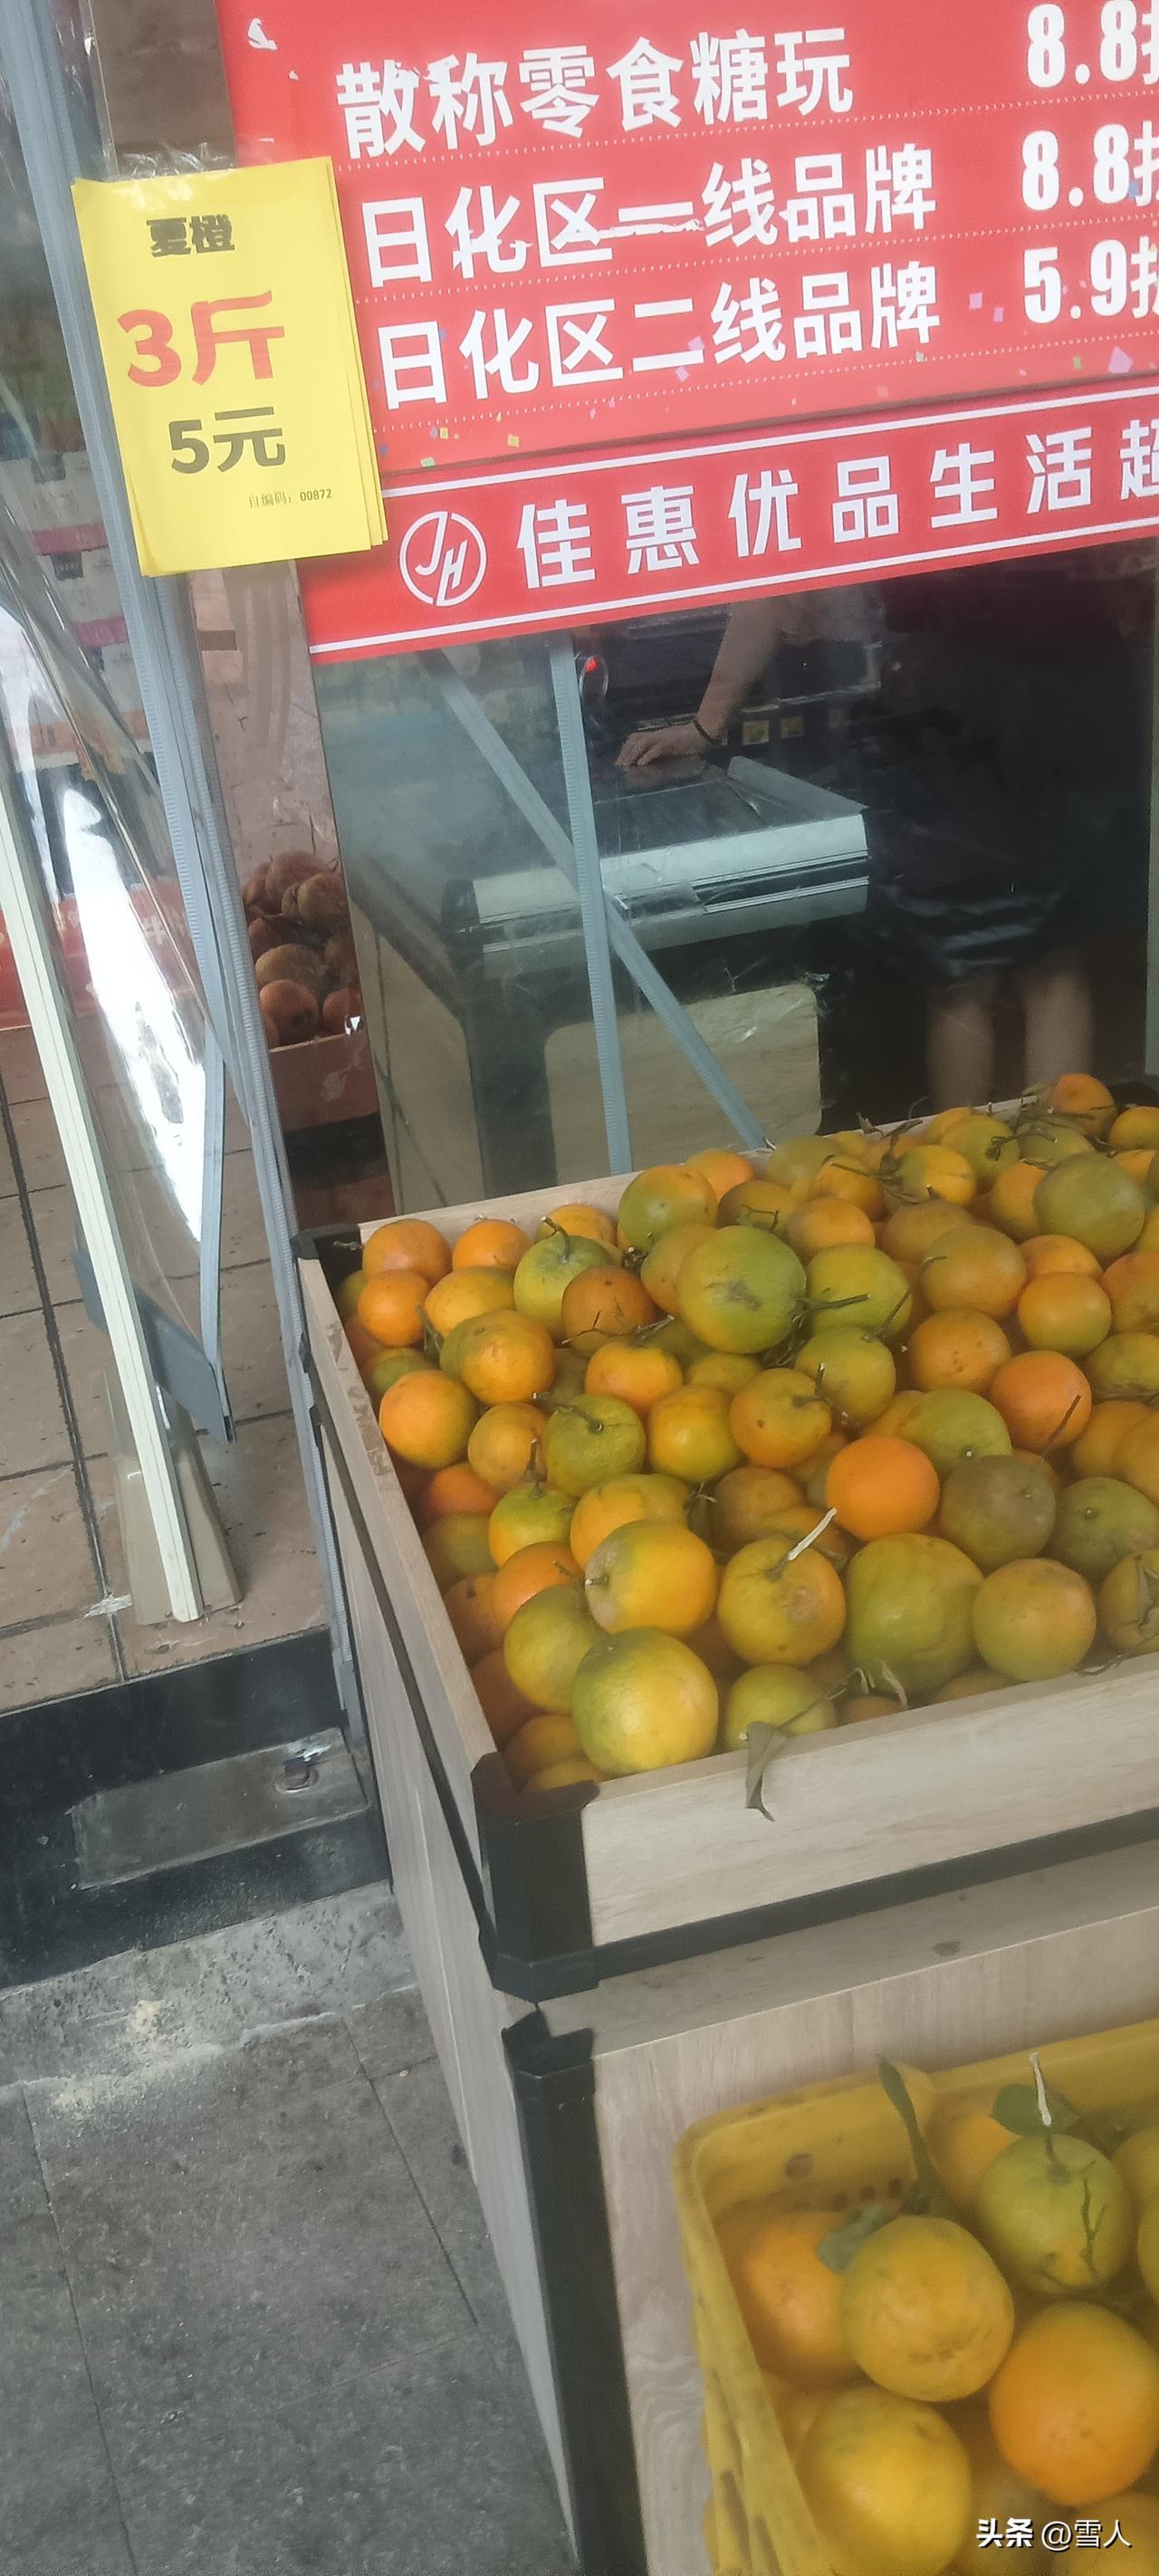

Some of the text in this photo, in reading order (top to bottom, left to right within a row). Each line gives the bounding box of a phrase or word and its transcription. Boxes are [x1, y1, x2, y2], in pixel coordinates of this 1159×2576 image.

[336, 27, 853, 159] 散称零食糖玩
[146, 214, 235, 258] 夏橙
[361, 143, 936, 288] 日化区一线品牌
[117, 290, 285, 388] 3斤
[378, 260, 940, 410] 日化区二线品牌
[168, 406, 286, 475] 5元
